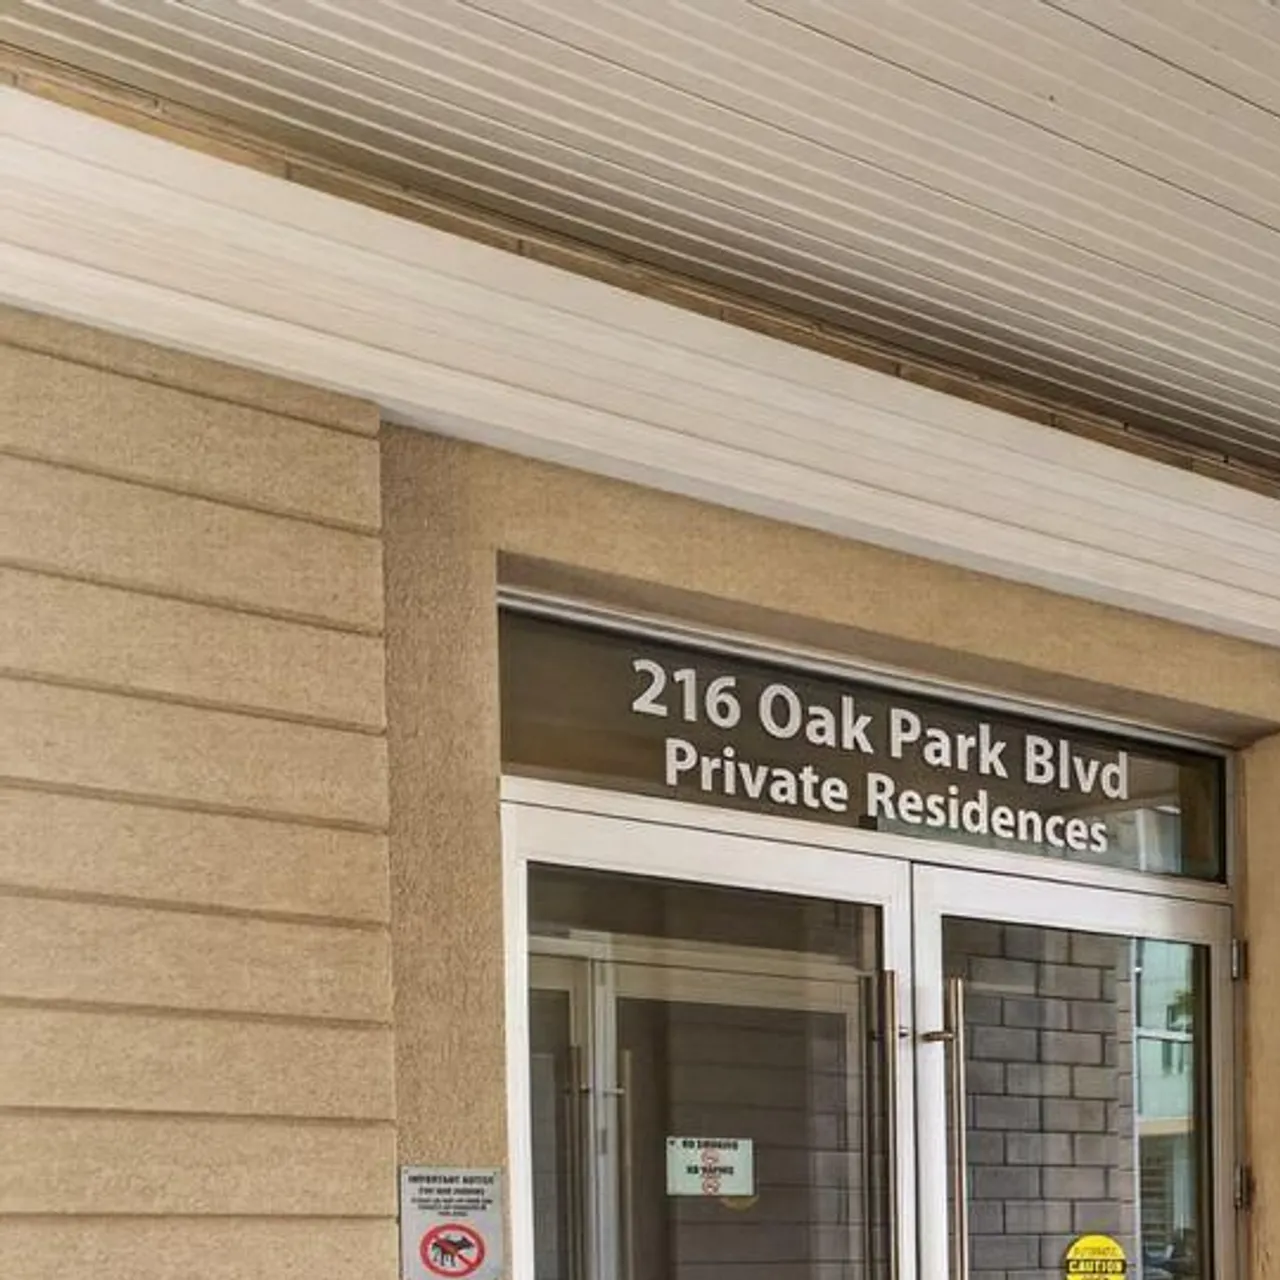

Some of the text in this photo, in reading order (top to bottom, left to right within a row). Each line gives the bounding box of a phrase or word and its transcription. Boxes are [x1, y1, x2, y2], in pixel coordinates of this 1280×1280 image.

[632, 658, 1129, 801] 216 Oak Park Blvd
[664, 737, 1108, 854] Private Residences
[1069, 1260, 1122, 1273] CAUTION
